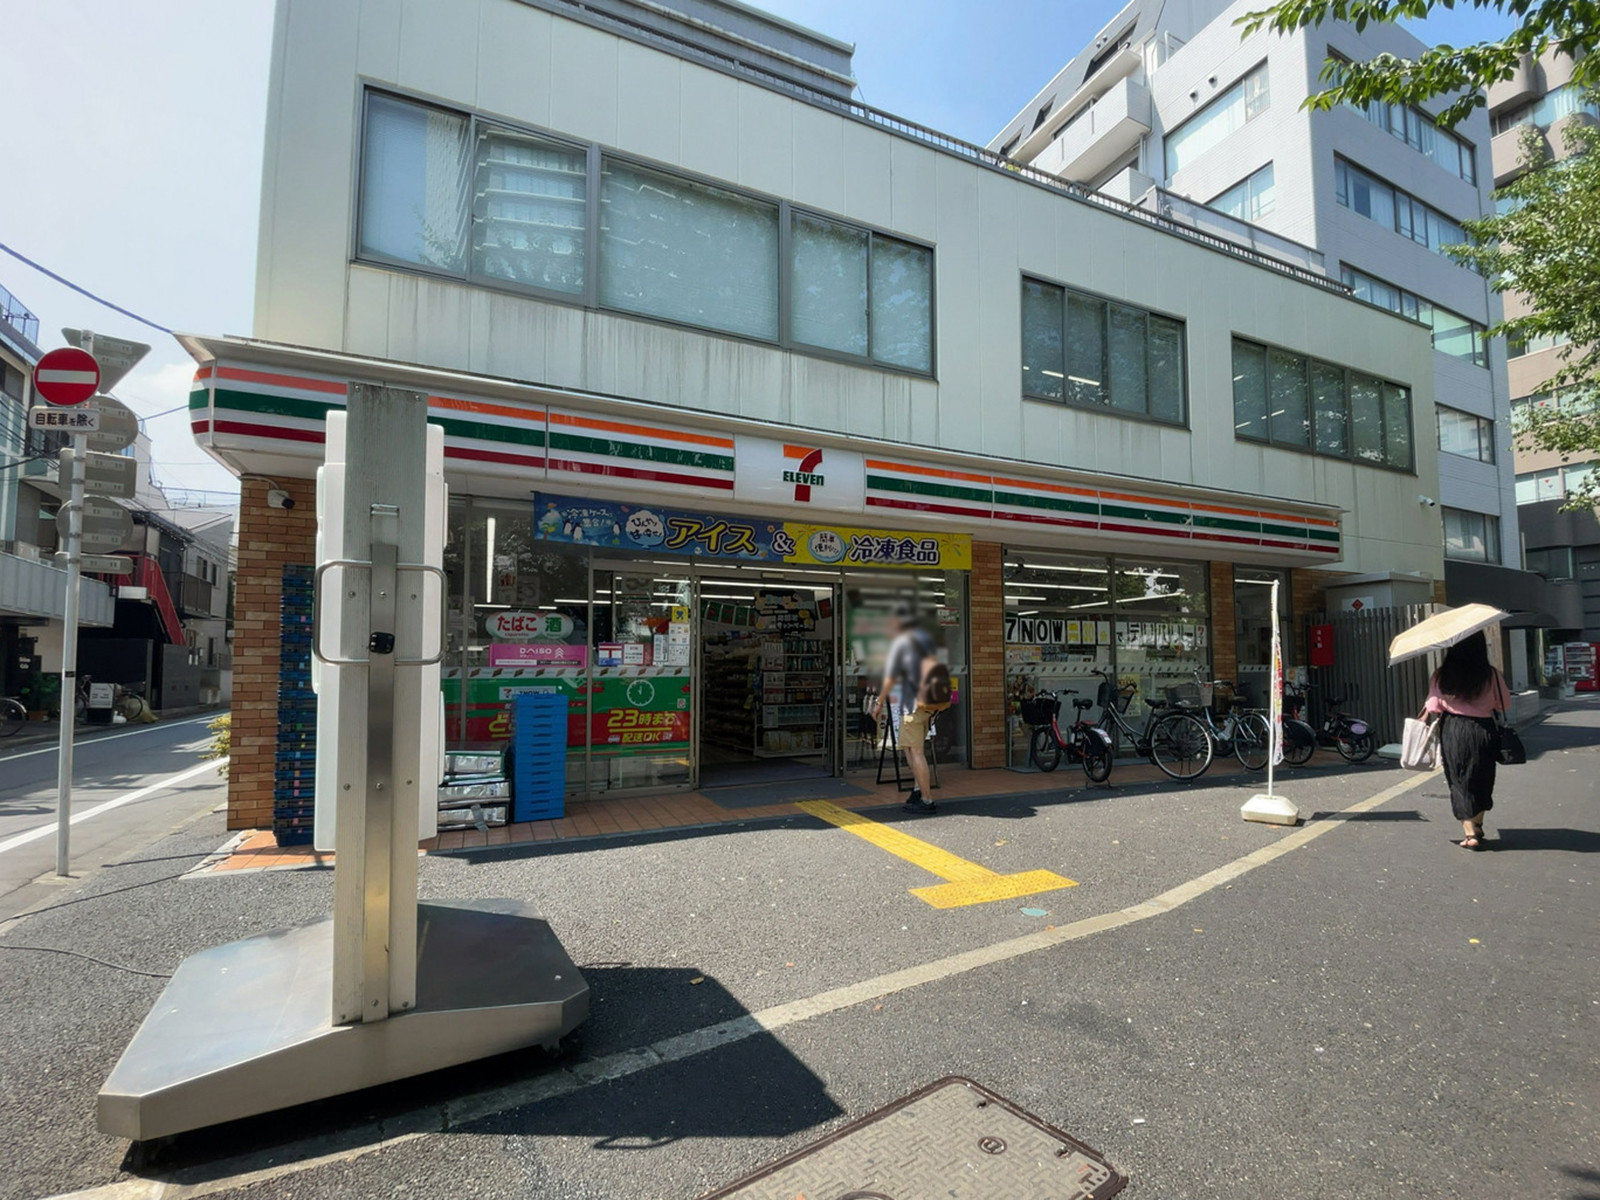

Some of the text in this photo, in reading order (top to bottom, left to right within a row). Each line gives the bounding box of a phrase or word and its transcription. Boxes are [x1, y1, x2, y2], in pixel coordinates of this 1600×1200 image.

[36, 412, 95, 427] 自転車を除く
[666, 518, 939, 563] アイス & 冷凍食品
[497, 616, 562, 632] たばこ 酒
[520, 647, 553, 655] DAISO
[607, 709, 676, 728] 23時まで
